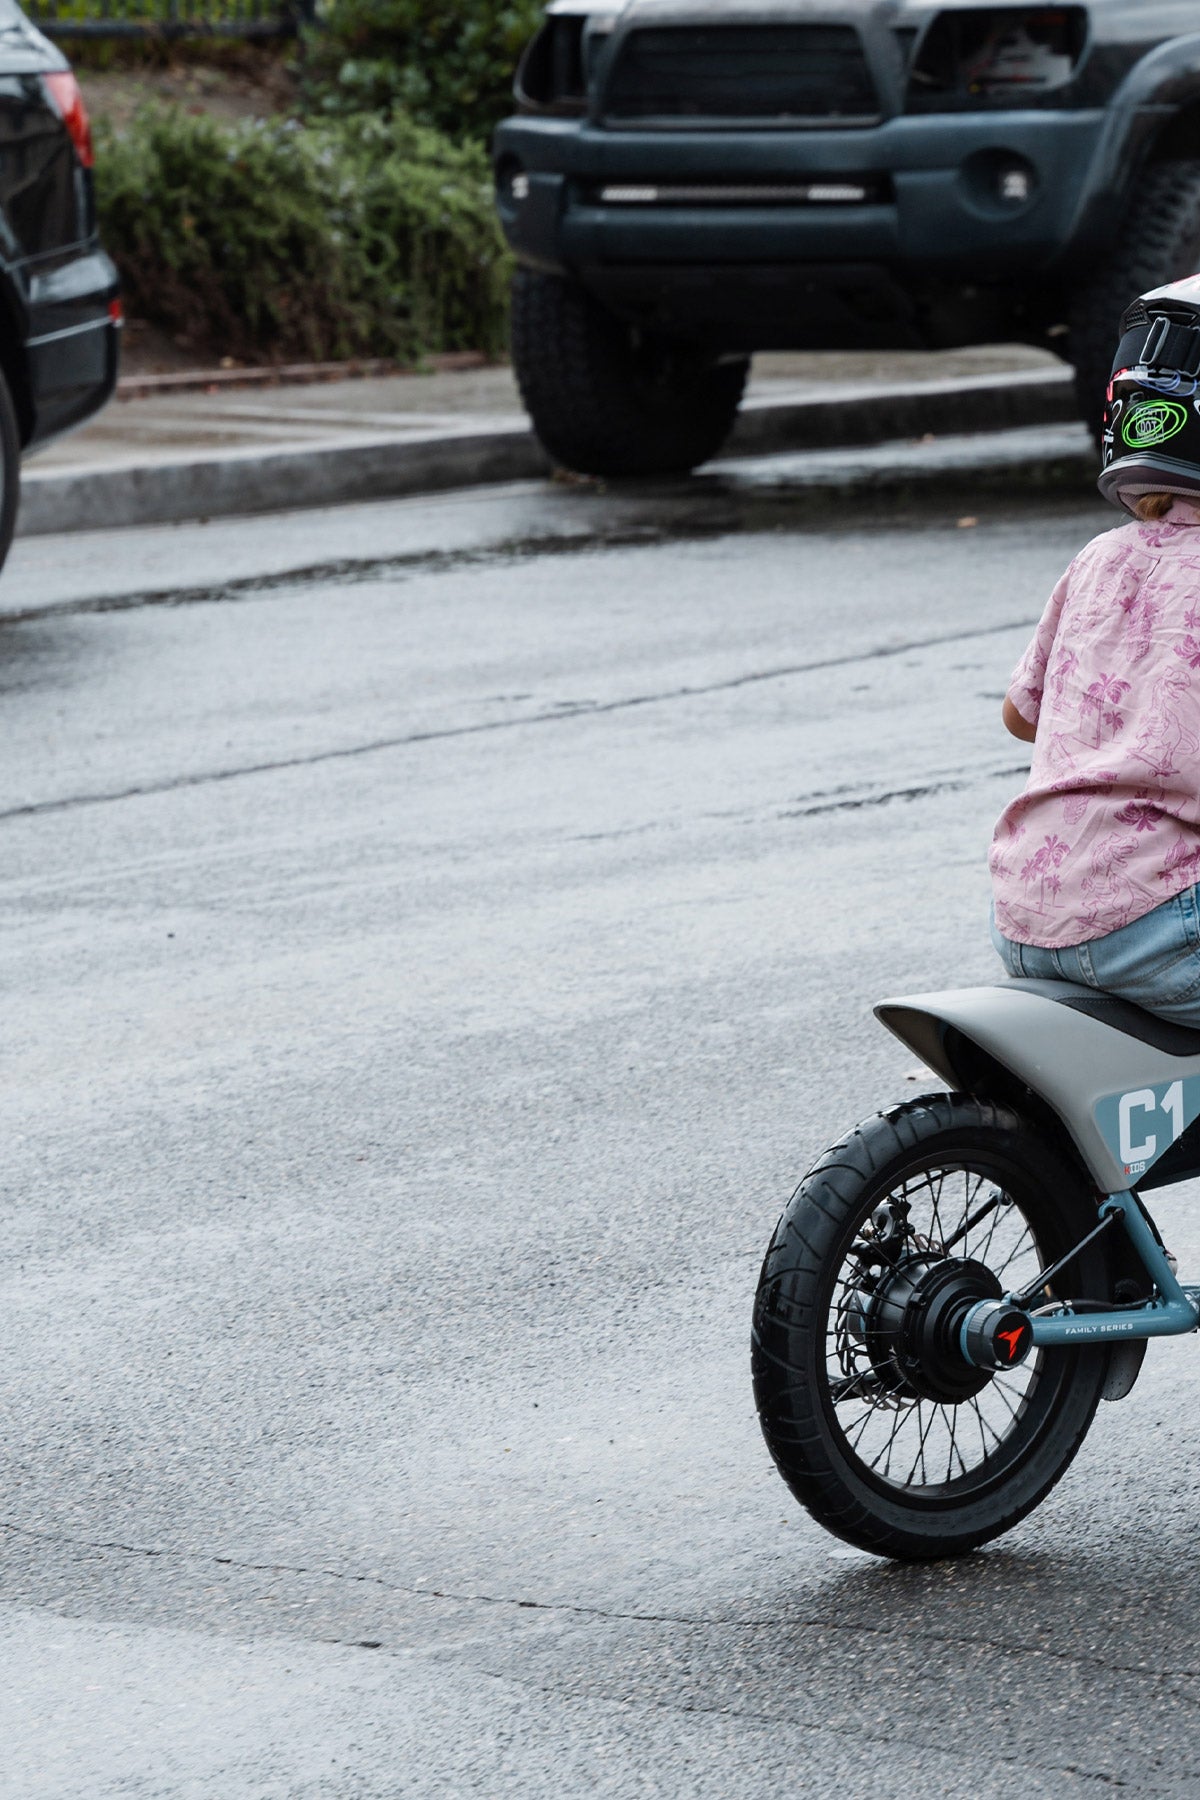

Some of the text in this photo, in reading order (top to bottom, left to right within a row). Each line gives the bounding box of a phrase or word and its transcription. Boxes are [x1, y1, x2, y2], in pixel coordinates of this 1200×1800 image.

[1140, 420, 1157, 433] DOT
[1119, 1080, 1184, 1164] C1
[1123, 1161, 1146, 1176] KIDS
[1064, 1323, 1134, 1335] FAMILY SERIES
